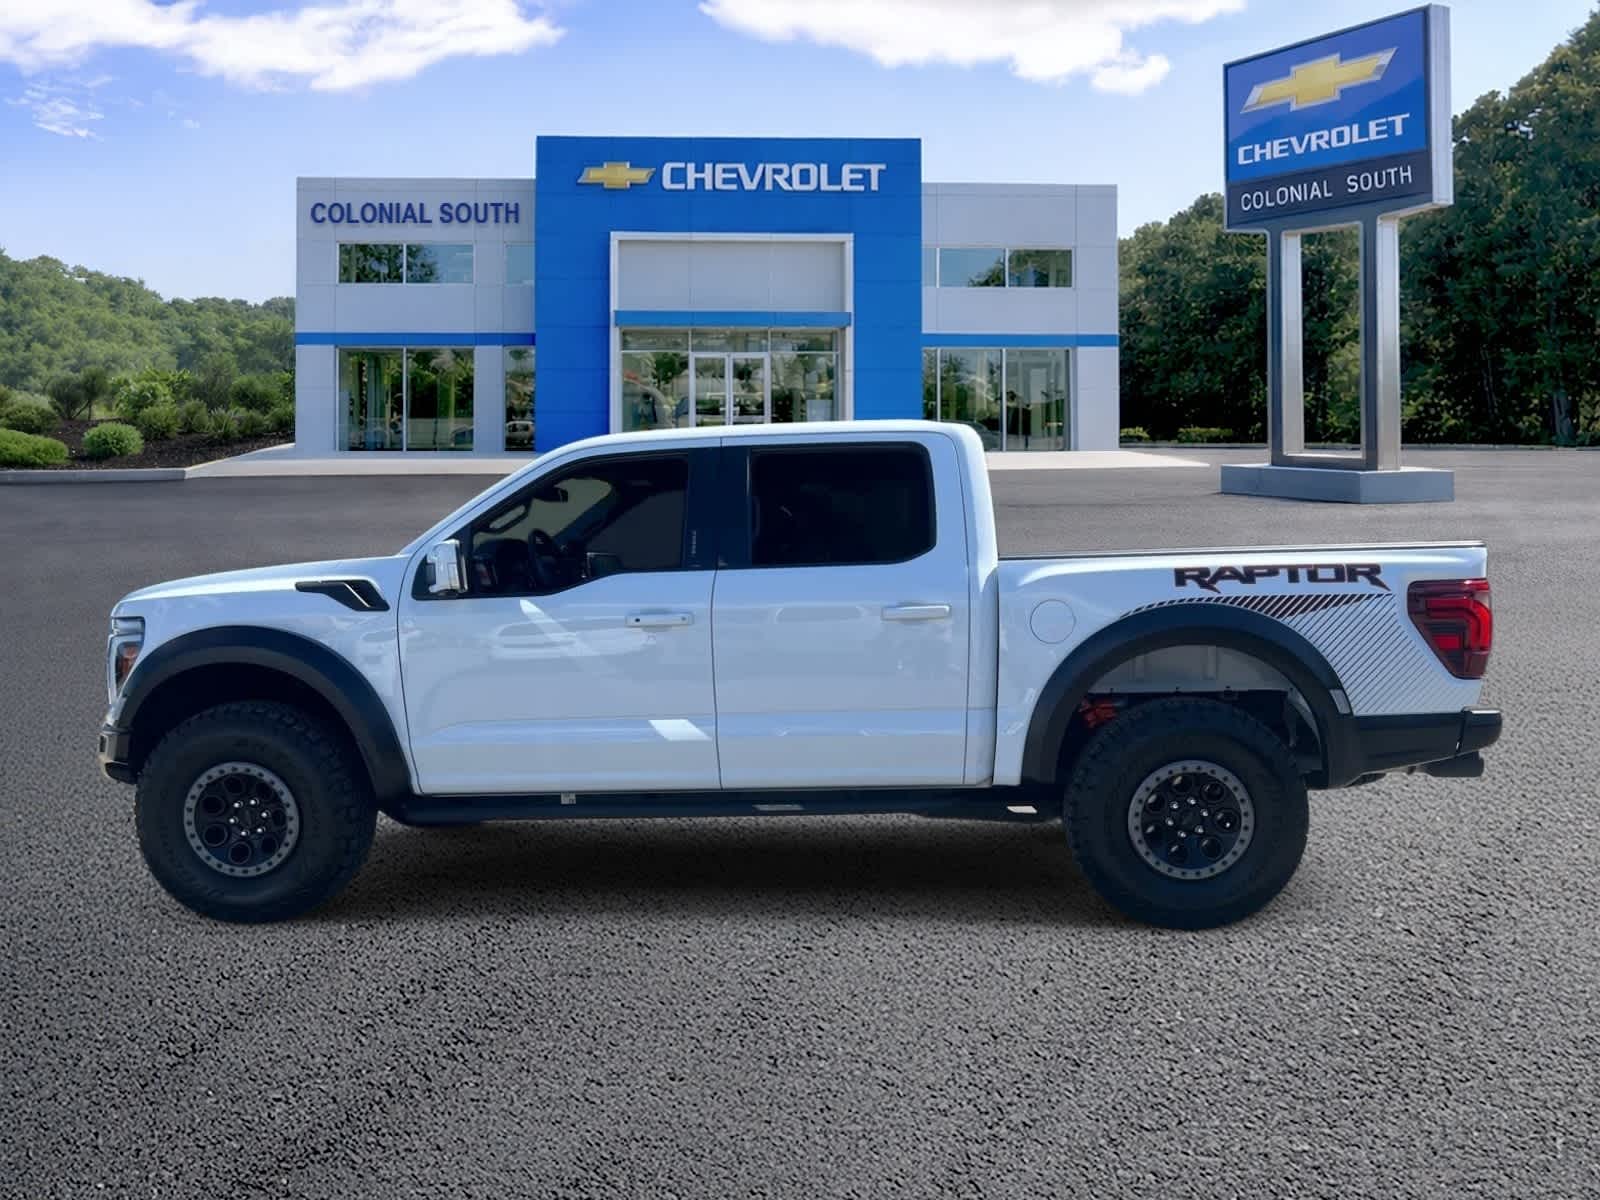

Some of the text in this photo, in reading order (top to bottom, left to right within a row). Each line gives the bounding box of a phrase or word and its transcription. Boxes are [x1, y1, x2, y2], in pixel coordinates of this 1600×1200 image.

[1237, 113, 1410, 165] CHEVROLET
[662, 162, 887, 191] CHEVROLET
[1241, 165, 1413, 212] COLONIAL SOUTH
[310, 202, 520, 224] COLONIAL SOUTH
[1174, 563, 1391, 594] RAPTOR
